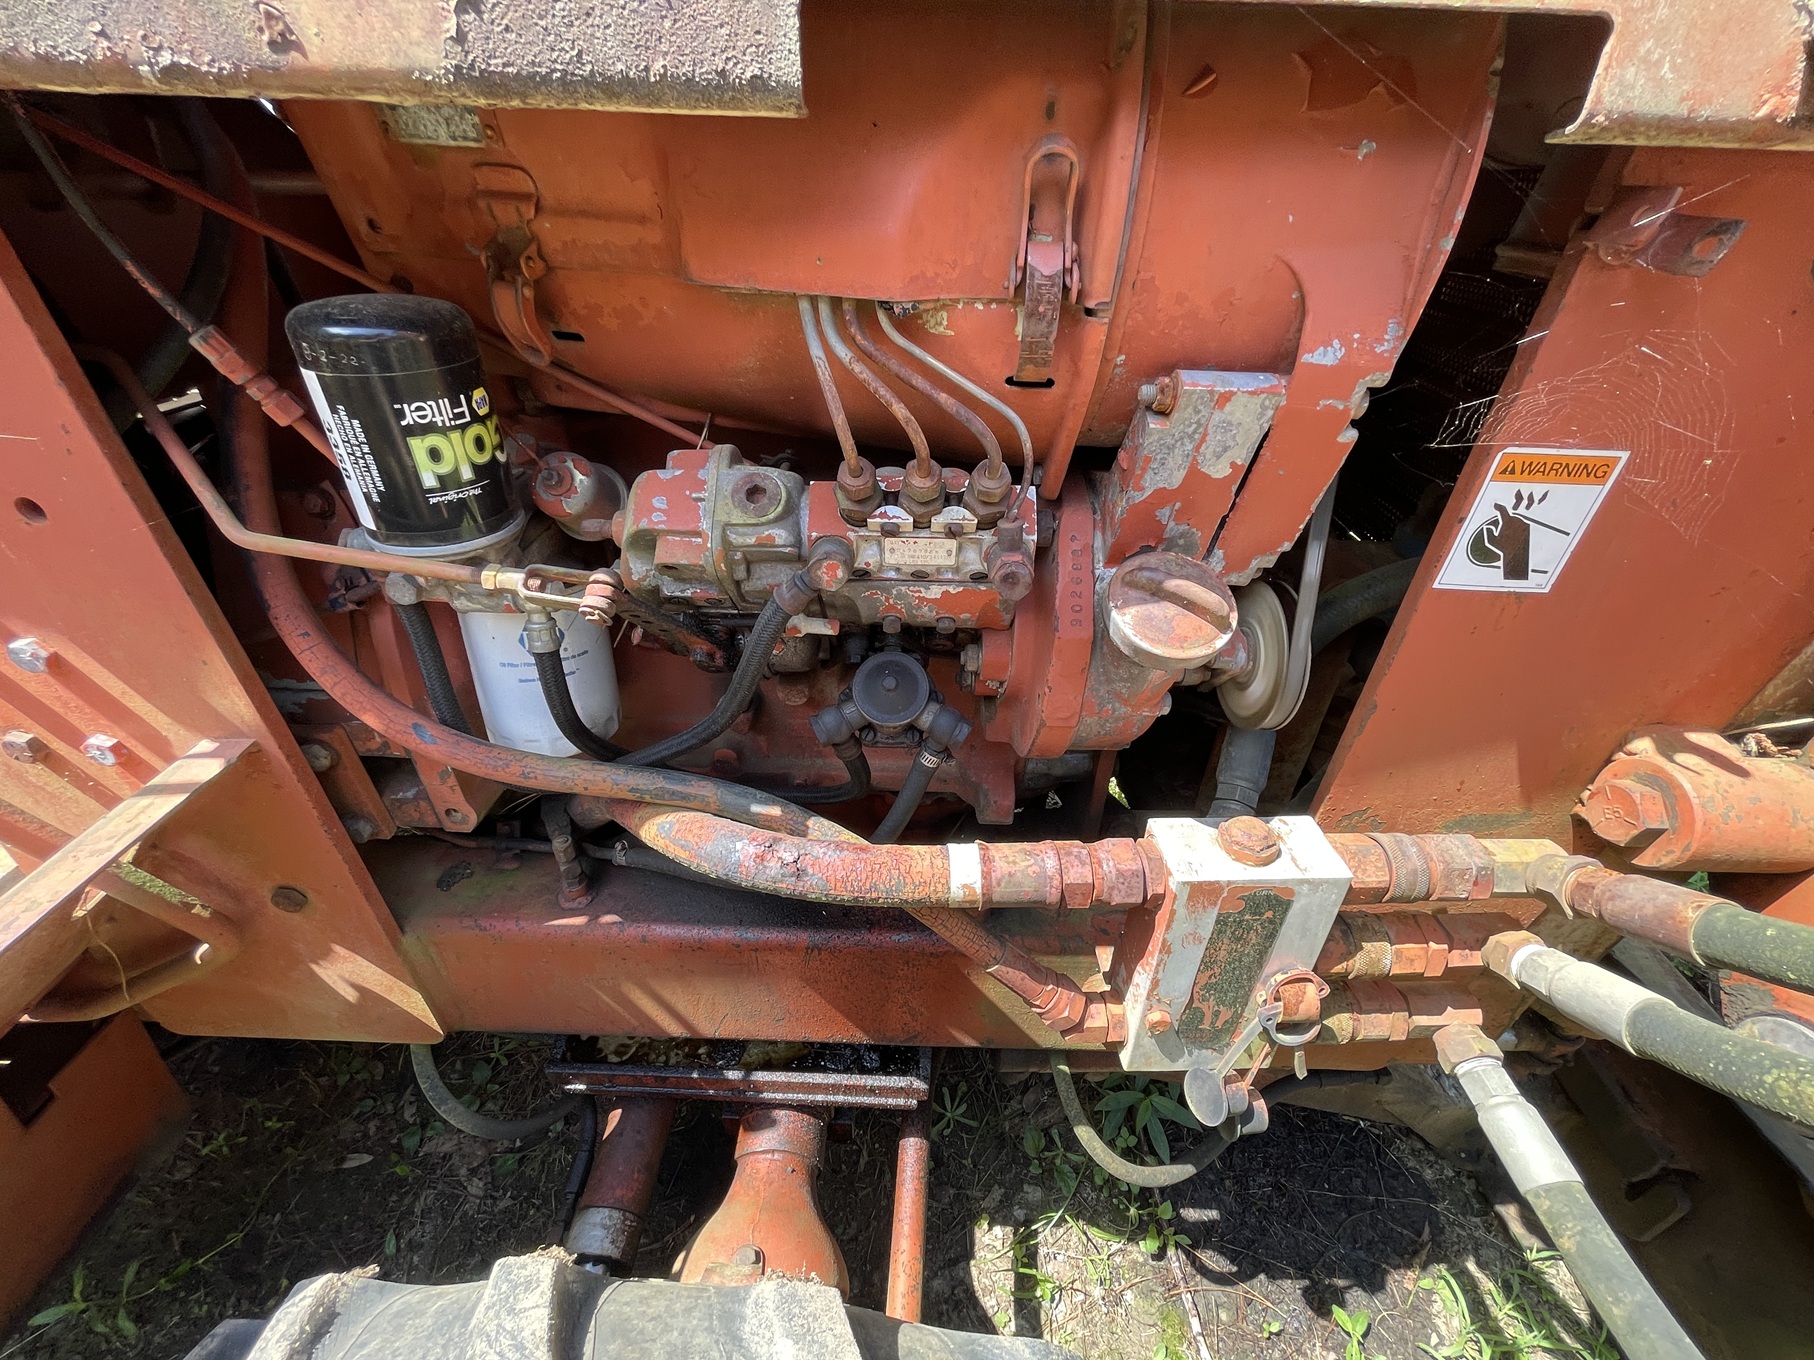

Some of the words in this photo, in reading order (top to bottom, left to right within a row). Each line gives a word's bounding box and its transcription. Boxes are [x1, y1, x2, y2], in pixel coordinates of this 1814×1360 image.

[336, 404, 360, 446] FABRIQUÉ
[400, 394, 471, 426] Filter
[351, 419, 367, 443] MADE
[332, 413, 348, 441] HECHO
[343, 442, 353, 454] EN
[348, 454, 368, 493] ALEMANIA
[353, 446, 363, 457] EN
[361, 443, 371, 453] IN
[407, 414, 507, 490] Gold
[356, 457, 381, 503] ALLEMAGNE
[364, 453, 386, 492] GERMANY
[1519, 460, 1610, 479] WARNING
[428, 490, 469, 504] Original
